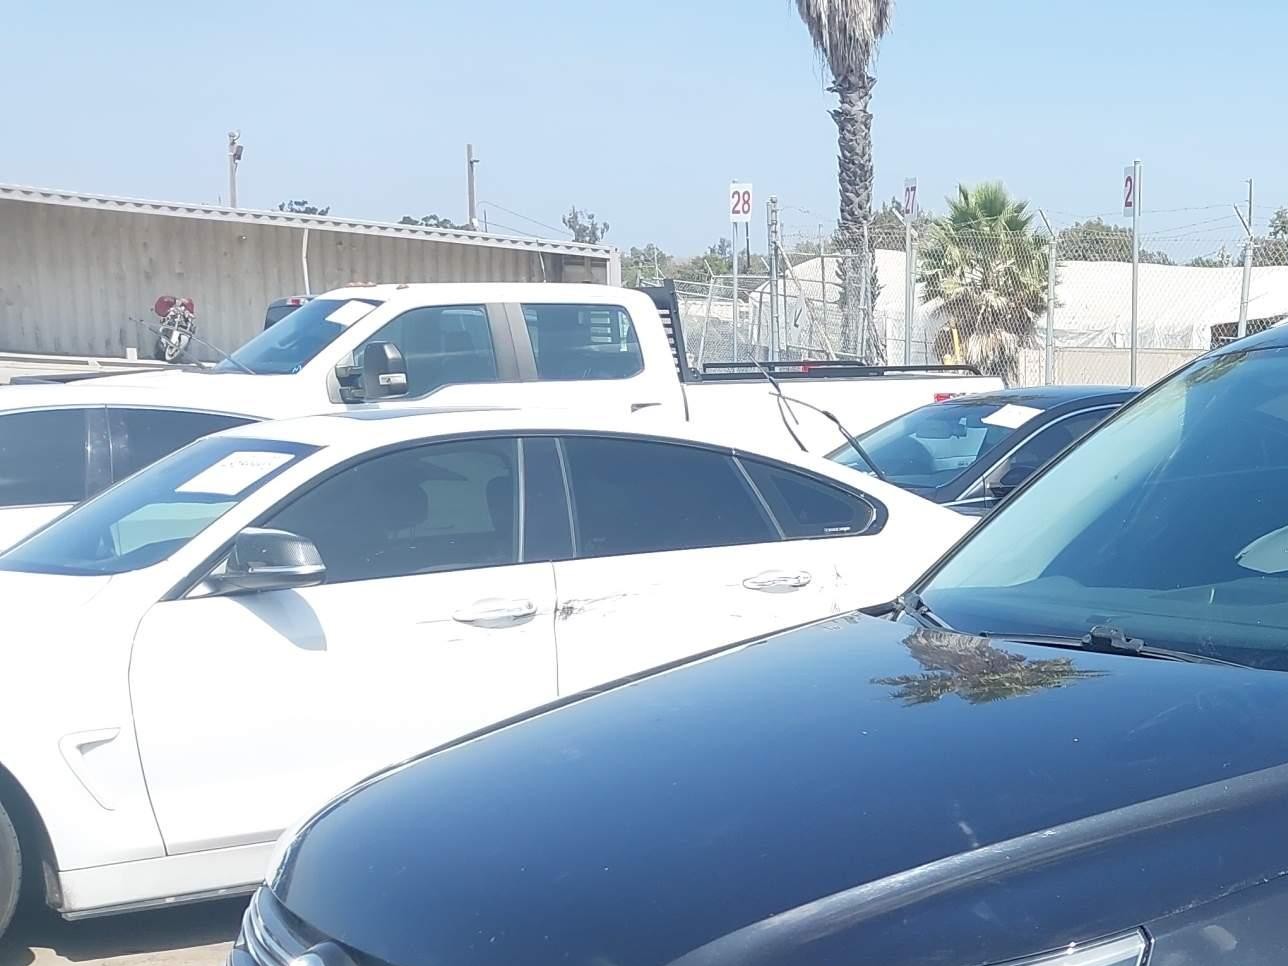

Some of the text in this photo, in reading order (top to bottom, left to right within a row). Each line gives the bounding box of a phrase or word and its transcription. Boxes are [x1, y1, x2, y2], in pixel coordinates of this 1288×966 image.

[732, 190, 750, 214] 28
[905, 186, 916, 214] 27
[1125, 176, 1133, 207] 2
